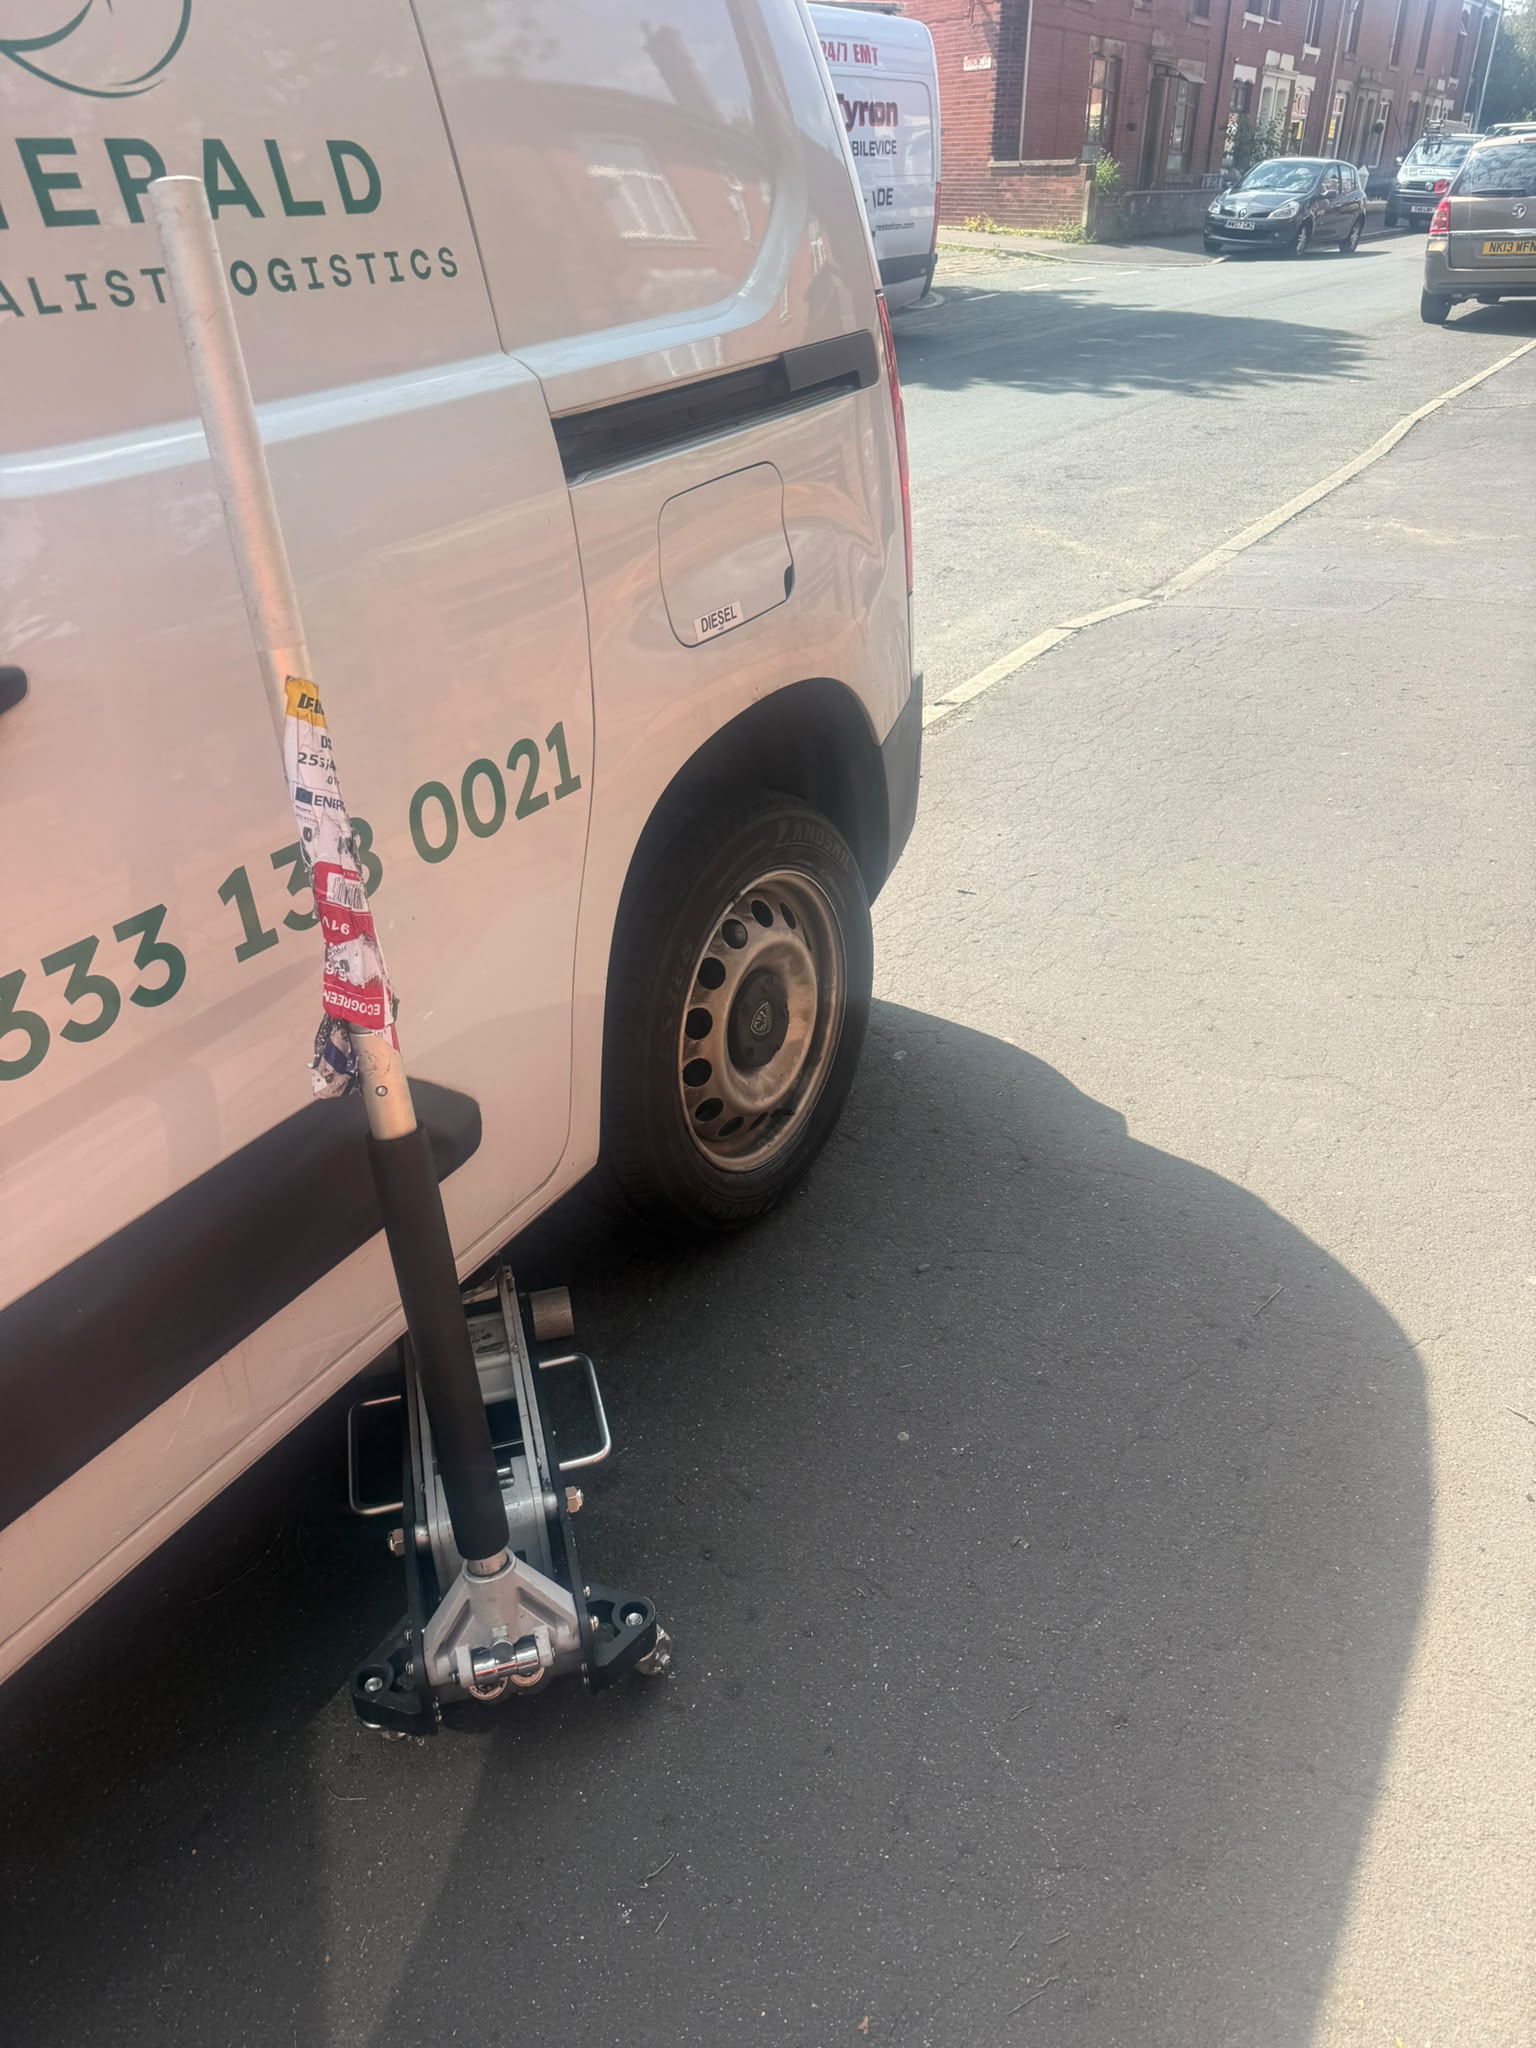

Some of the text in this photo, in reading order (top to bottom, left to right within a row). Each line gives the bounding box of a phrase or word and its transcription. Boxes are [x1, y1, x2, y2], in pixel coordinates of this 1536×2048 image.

[853, 43, 878, 66] EMT
[0, 137, 382, 230] ERALD
[1489, 241, 1514, 252] NK13
[229, 247, 458, 296] OGISTICS
[701, 605, 737, 633] DIESEL
[0, 903, 187, 1081] 333
[409, 721, 582, 864] 0021
